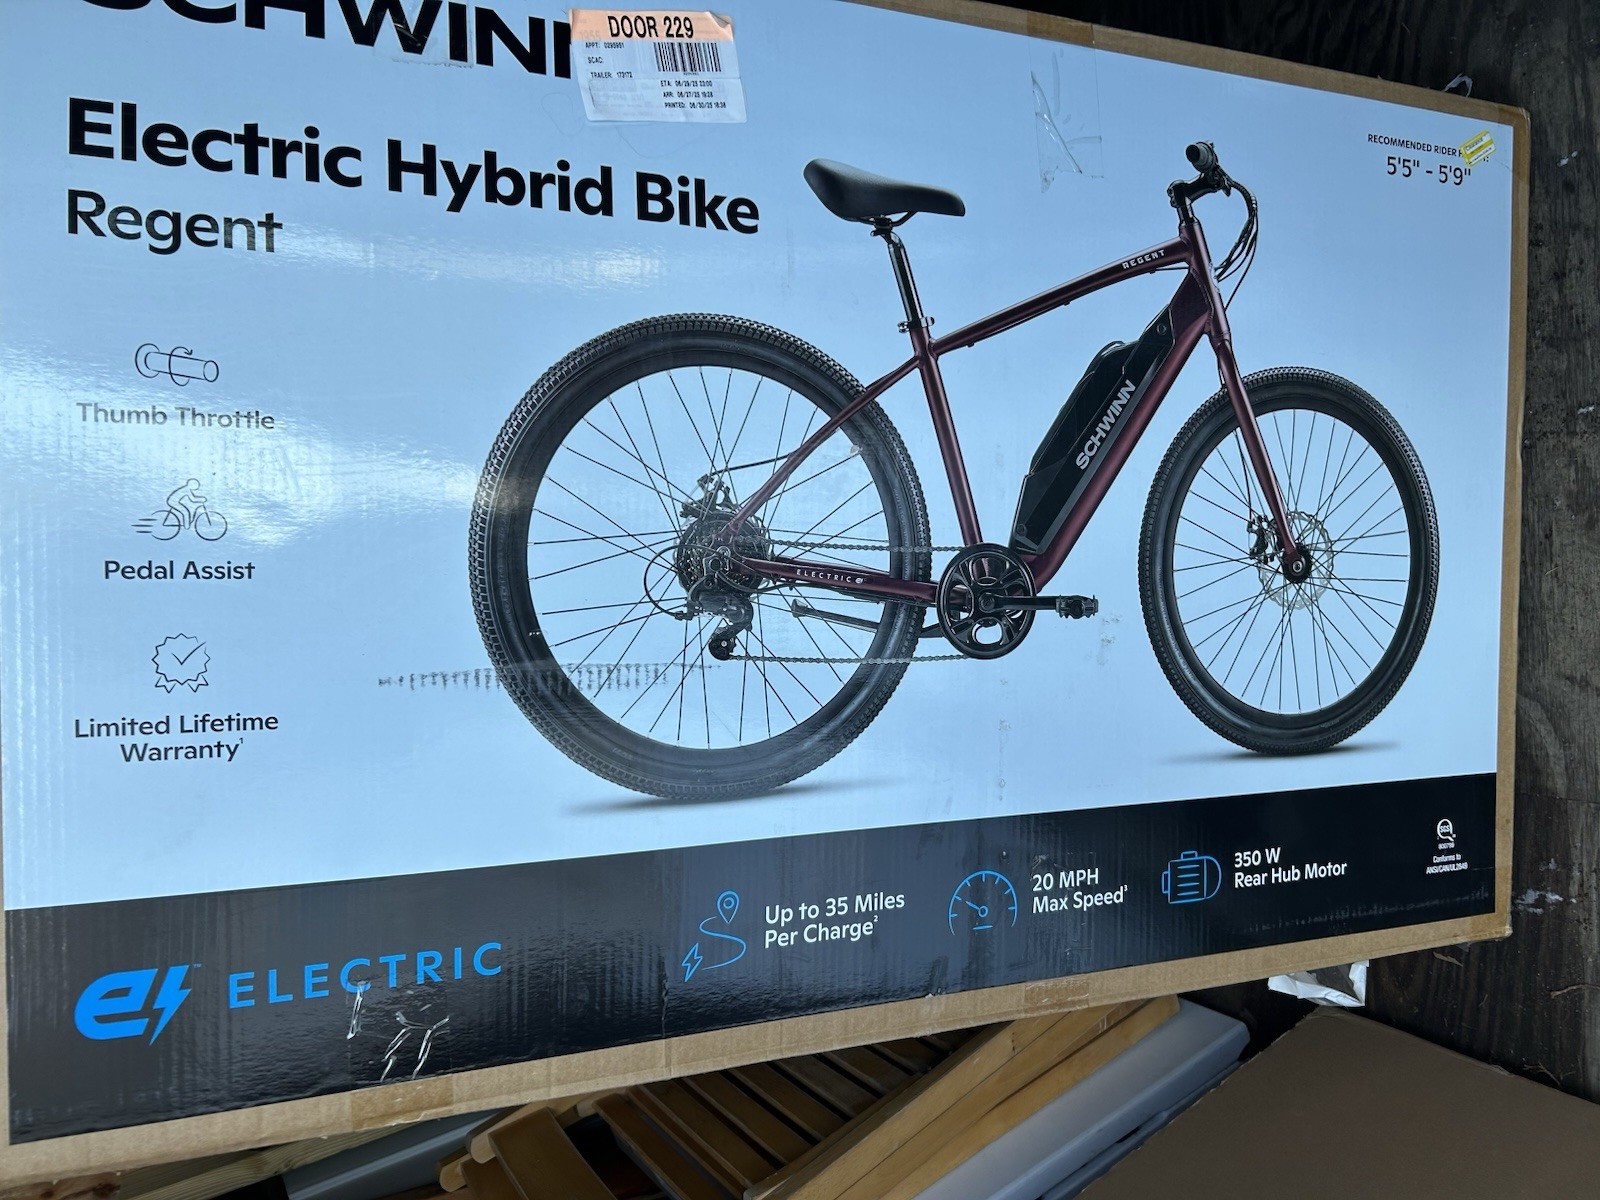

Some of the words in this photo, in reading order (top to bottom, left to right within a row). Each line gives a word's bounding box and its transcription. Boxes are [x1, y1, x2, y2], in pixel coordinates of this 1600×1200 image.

[607, 15, 658, 38] DOOR
[663, 16, 694, 38] 229
[1367, 133, 1433, 152] RECOMMENDED
[1433, 144, 1457, 157] RIDER
[67, 97, 363, 189] Electric
[387, 138, 613, 216] Hybrid
[634, 171, 760, 235] Bike
[66, 189, 283, 255] Regent
[1122, 249, 1166, 270] REGENT
[76, 402, 168, 426] Thumb
[175, 406, 275, 430] Throttle
[1075, 379, 1136, 470] SCHWINN
[104, 560, 175, 580] Pedal
[182, 561, 256, 580] Assist
[796, 568, 852, 583] ELECTRIC
[74, 715, 171, 738] Limited
[179, 712, 279, 734] Lifetime
[1234, 850, 1262, 868] 350
[1265, 847, 1281, 864] W
[1032, 873, 1054, 892] 20
[1059, 868, 1099, 889] MPH
[1234, 872, 1269, 888] Rear
[1271, 866, 1301, 883] Hub
[1304, 861, 1347, 879] Motor
[765, 904, 794, 927] Up
[799, 902, 820, 920] to
[825, 896, 849, 917] 35
[855, 892, 905, 913] Miles
[1032, 894, 1069, 913] Max
[764, 929, 798, 949] Per
[229, 942, 502, 1009] ELECTRIC
